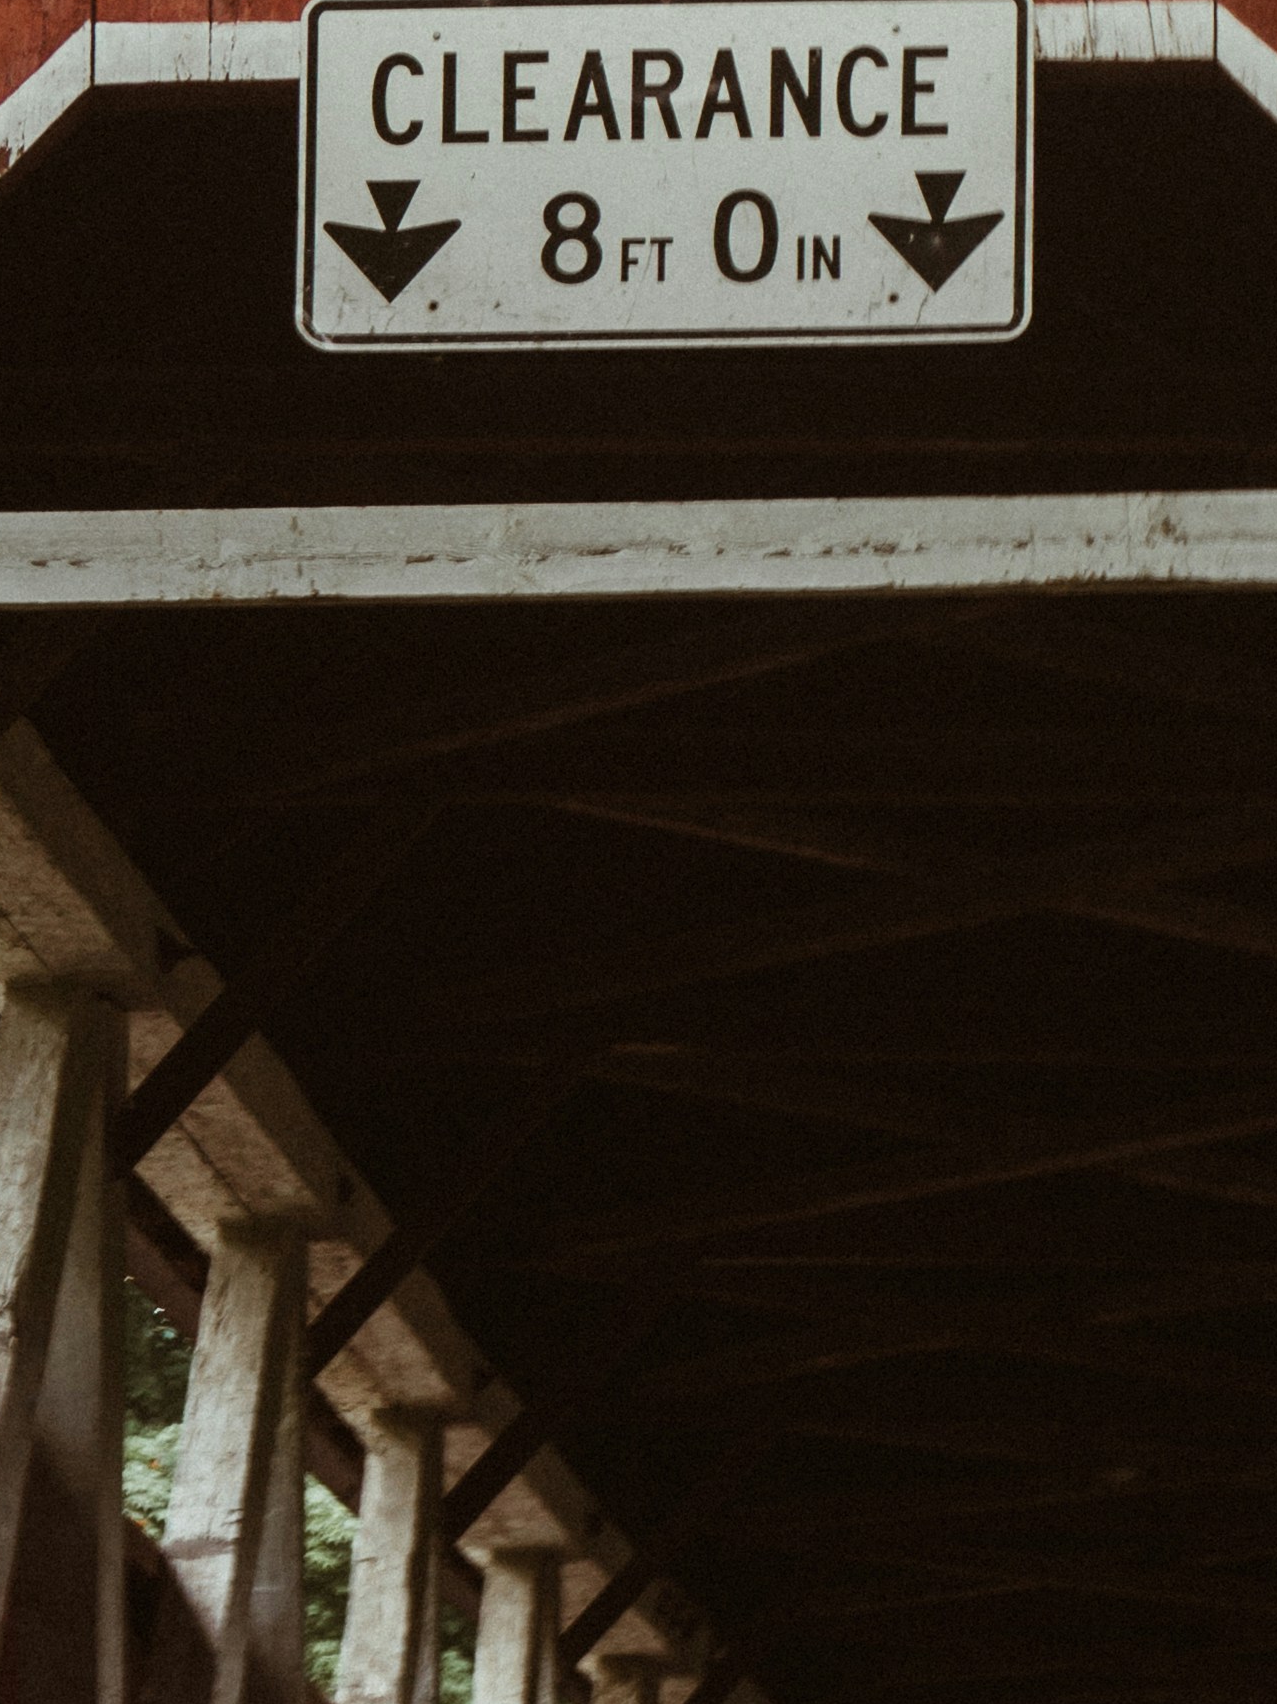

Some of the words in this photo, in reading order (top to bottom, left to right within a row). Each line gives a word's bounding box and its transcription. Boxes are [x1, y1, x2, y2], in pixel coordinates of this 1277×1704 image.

[371, 44, 950, 147] CLEARANCE
[539, 190, 604, 285] 8
[620, 236, 674, 283] FT
[712, 188, 780, 284] 0
[795, 234, 842, 281] IN
